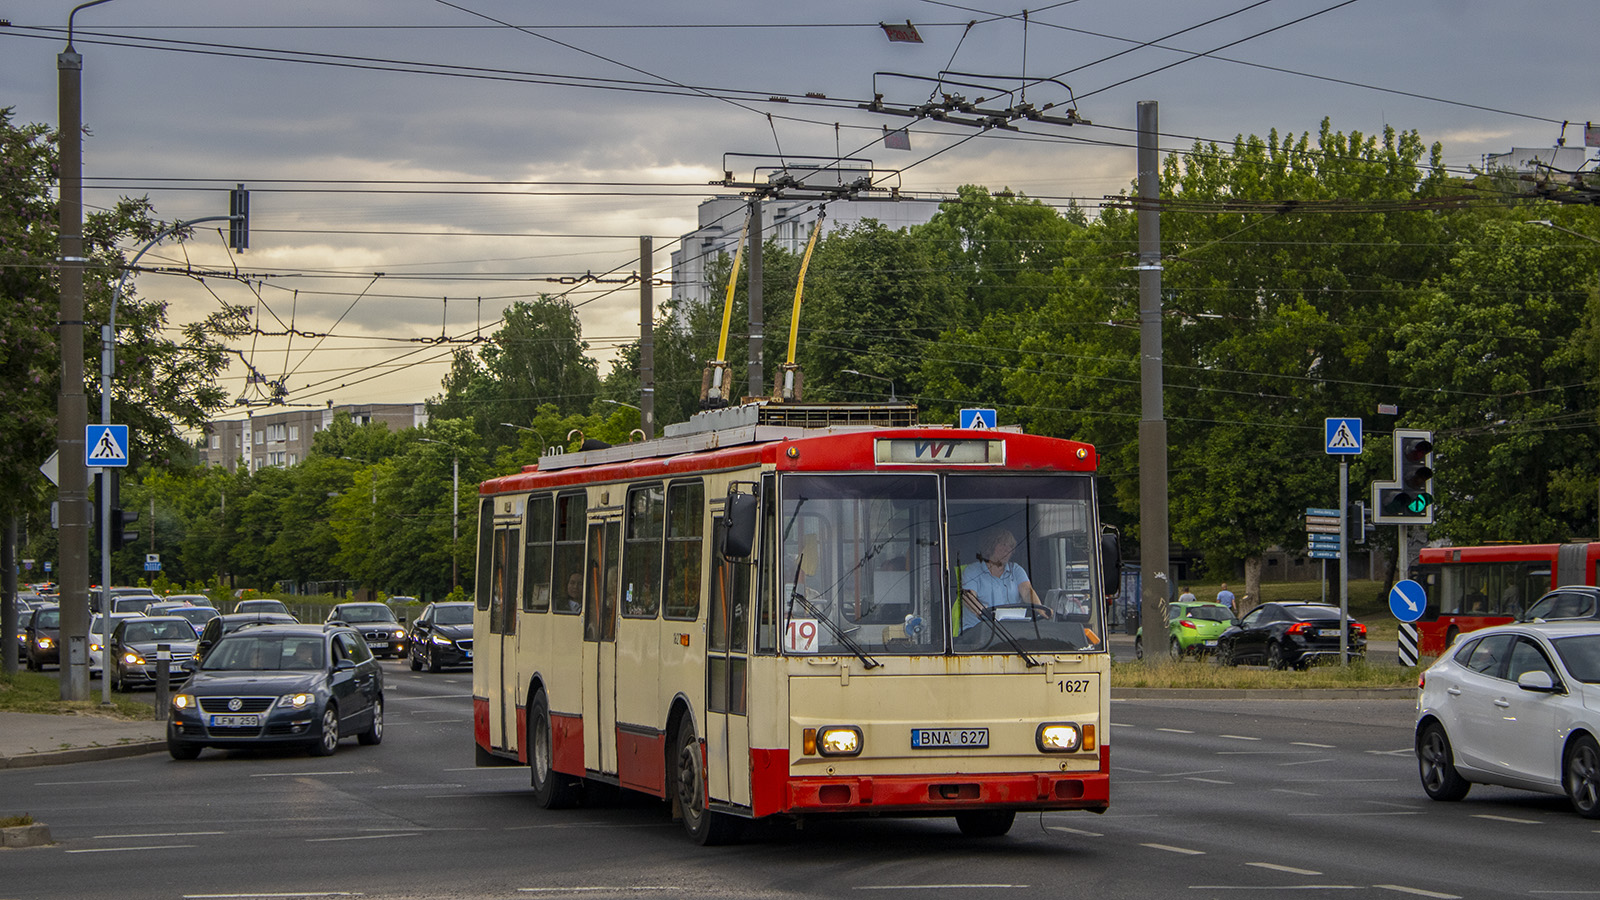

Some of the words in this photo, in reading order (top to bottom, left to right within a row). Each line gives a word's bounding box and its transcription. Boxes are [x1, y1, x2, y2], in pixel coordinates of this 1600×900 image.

[788, 622, 816, 650] 19
[1057, 680, 1090, 693] 1627
[240, 717, 257, 725] 259
[921, 731, 951, 744] BNA
[960, 731, 986, 744] 627
